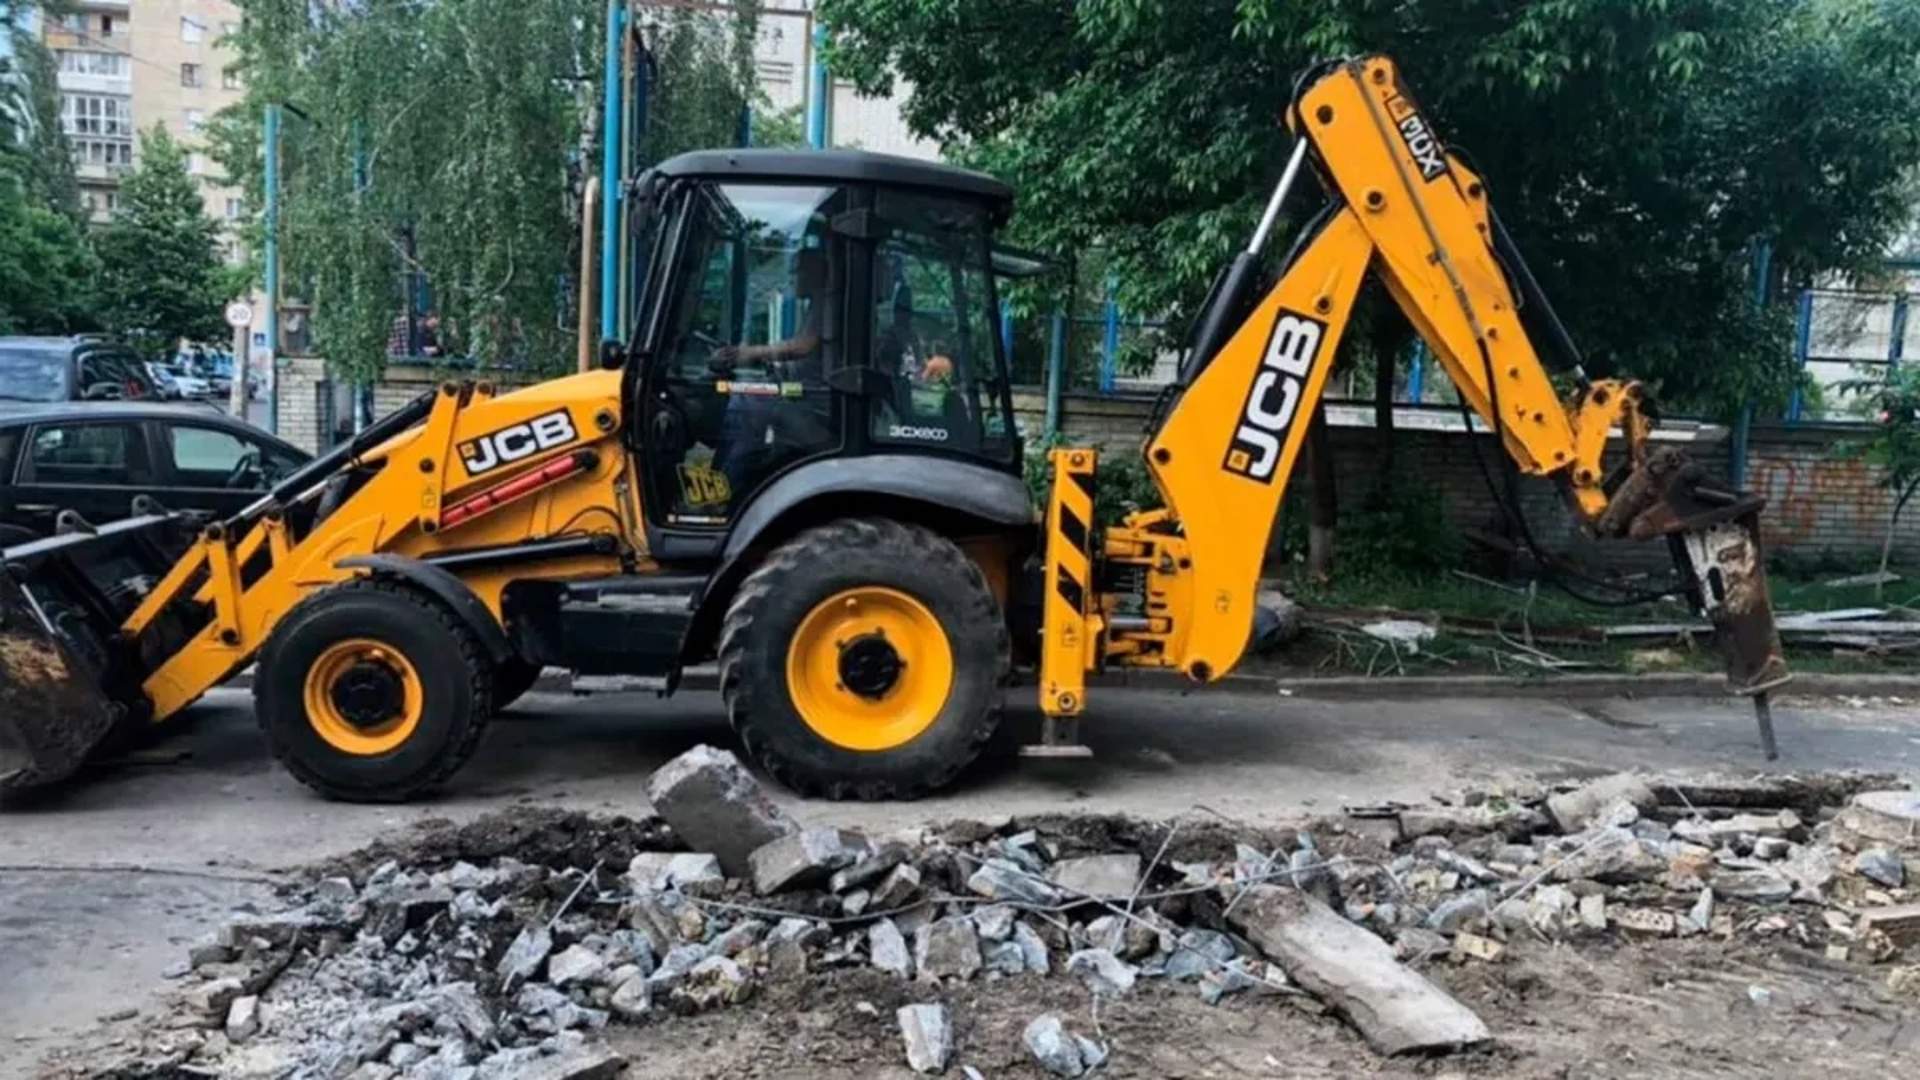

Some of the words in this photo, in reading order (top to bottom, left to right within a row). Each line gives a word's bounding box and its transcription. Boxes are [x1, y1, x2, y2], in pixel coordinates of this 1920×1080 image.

[1237, 315, 1321, 478] JCB
[465, 411, 576, 473] JCB
[686, 467, 730, 502] JCB
